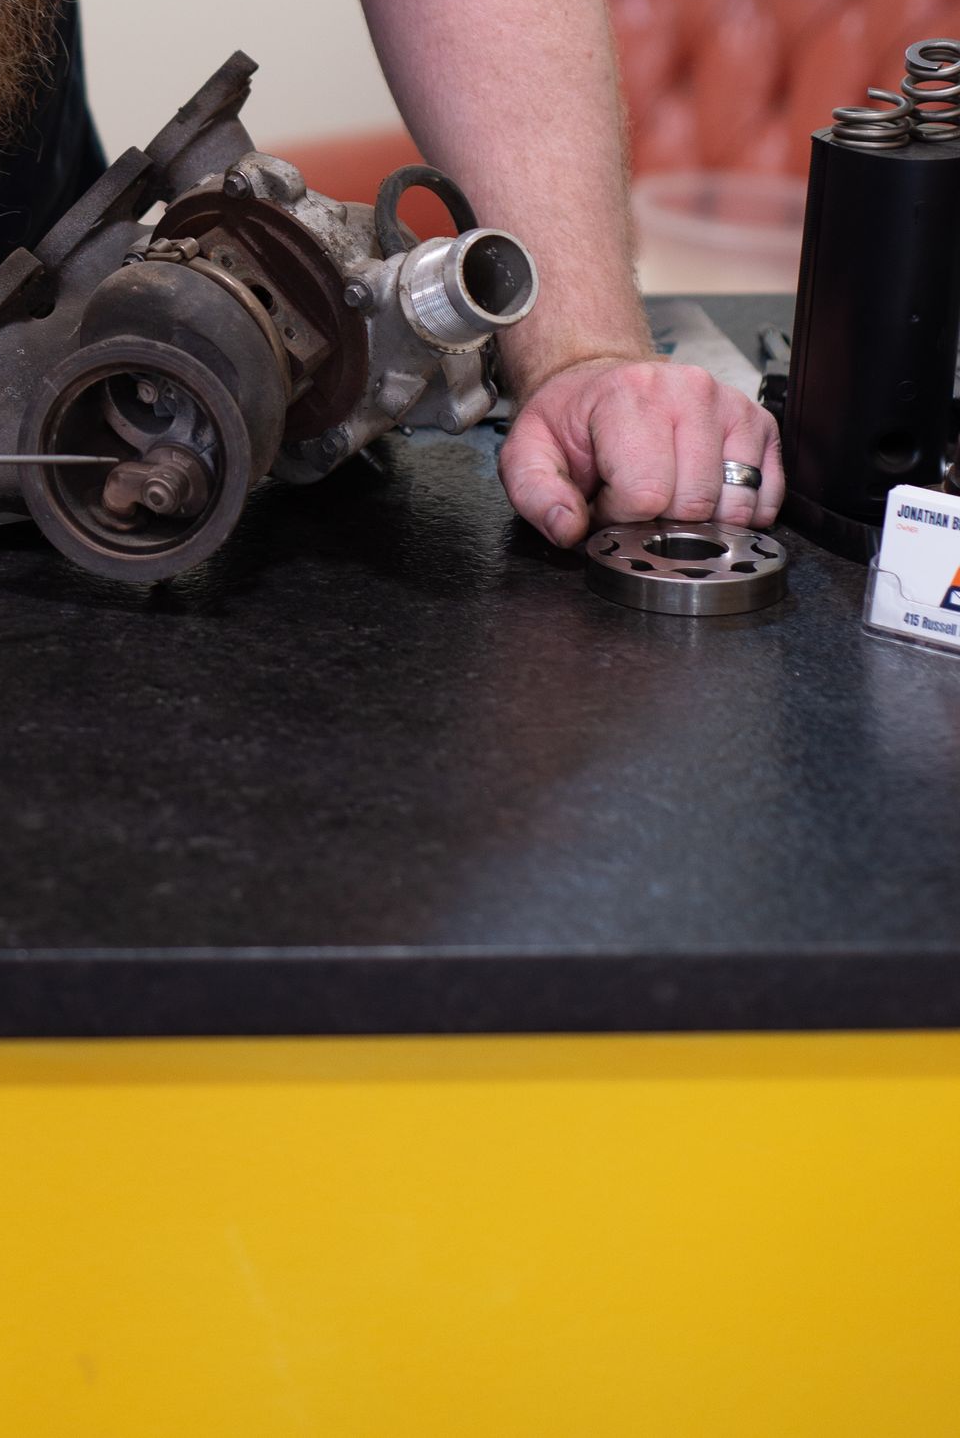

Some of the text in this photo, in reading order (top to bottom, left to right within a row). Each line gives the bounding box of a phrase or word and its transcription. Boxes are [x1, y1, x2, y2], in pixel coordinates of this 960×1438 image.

[897, 504, 949, 528] JONATHAN
[904, 612, 957, 636] 415 Russell
